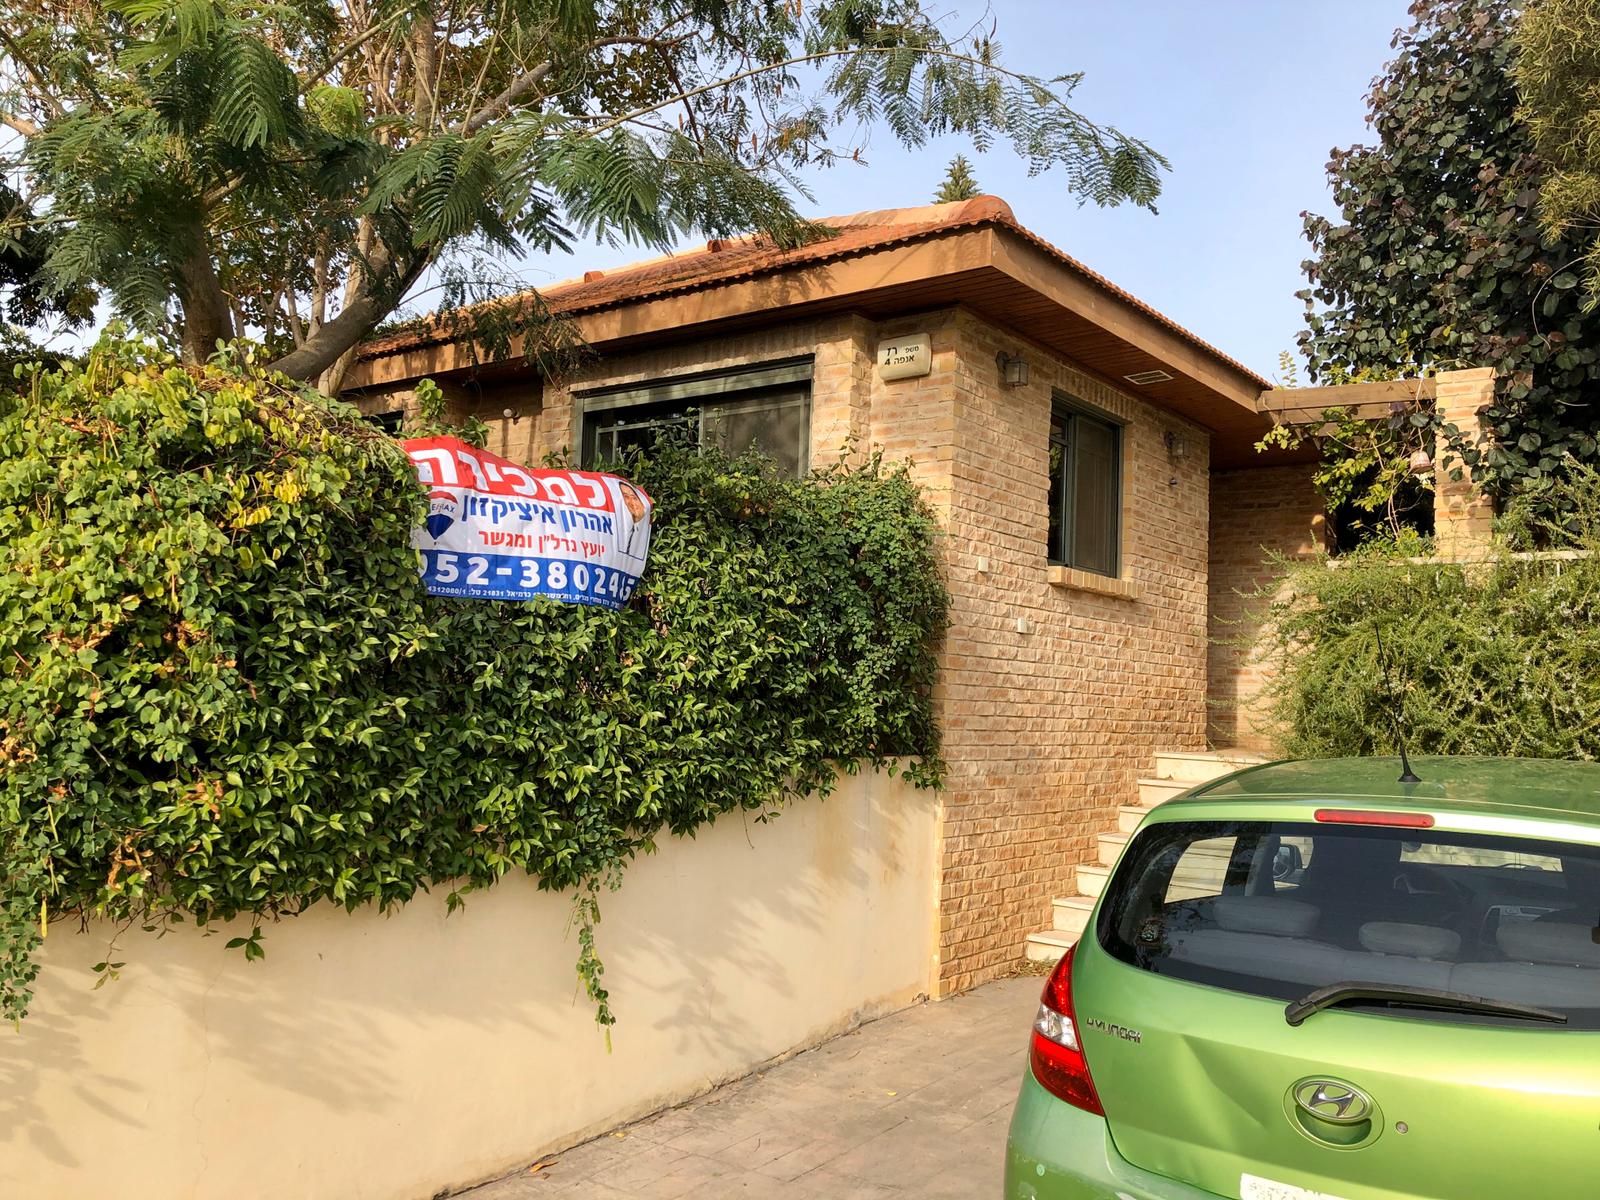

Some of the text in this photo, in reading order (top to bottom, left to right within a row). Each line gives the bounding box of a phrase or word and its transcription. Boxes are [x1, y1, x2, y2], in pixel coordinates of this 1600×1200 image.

[884, 354, 915, 366] אנפה 4
[887, 346, 898, 356] רז
[409, 447, 607, 509] למכירה
[560, 509, 613, 536] אהרון
[478, 530, 532, 549] ומגשר
[581, 540, 605, 559] יועץ
